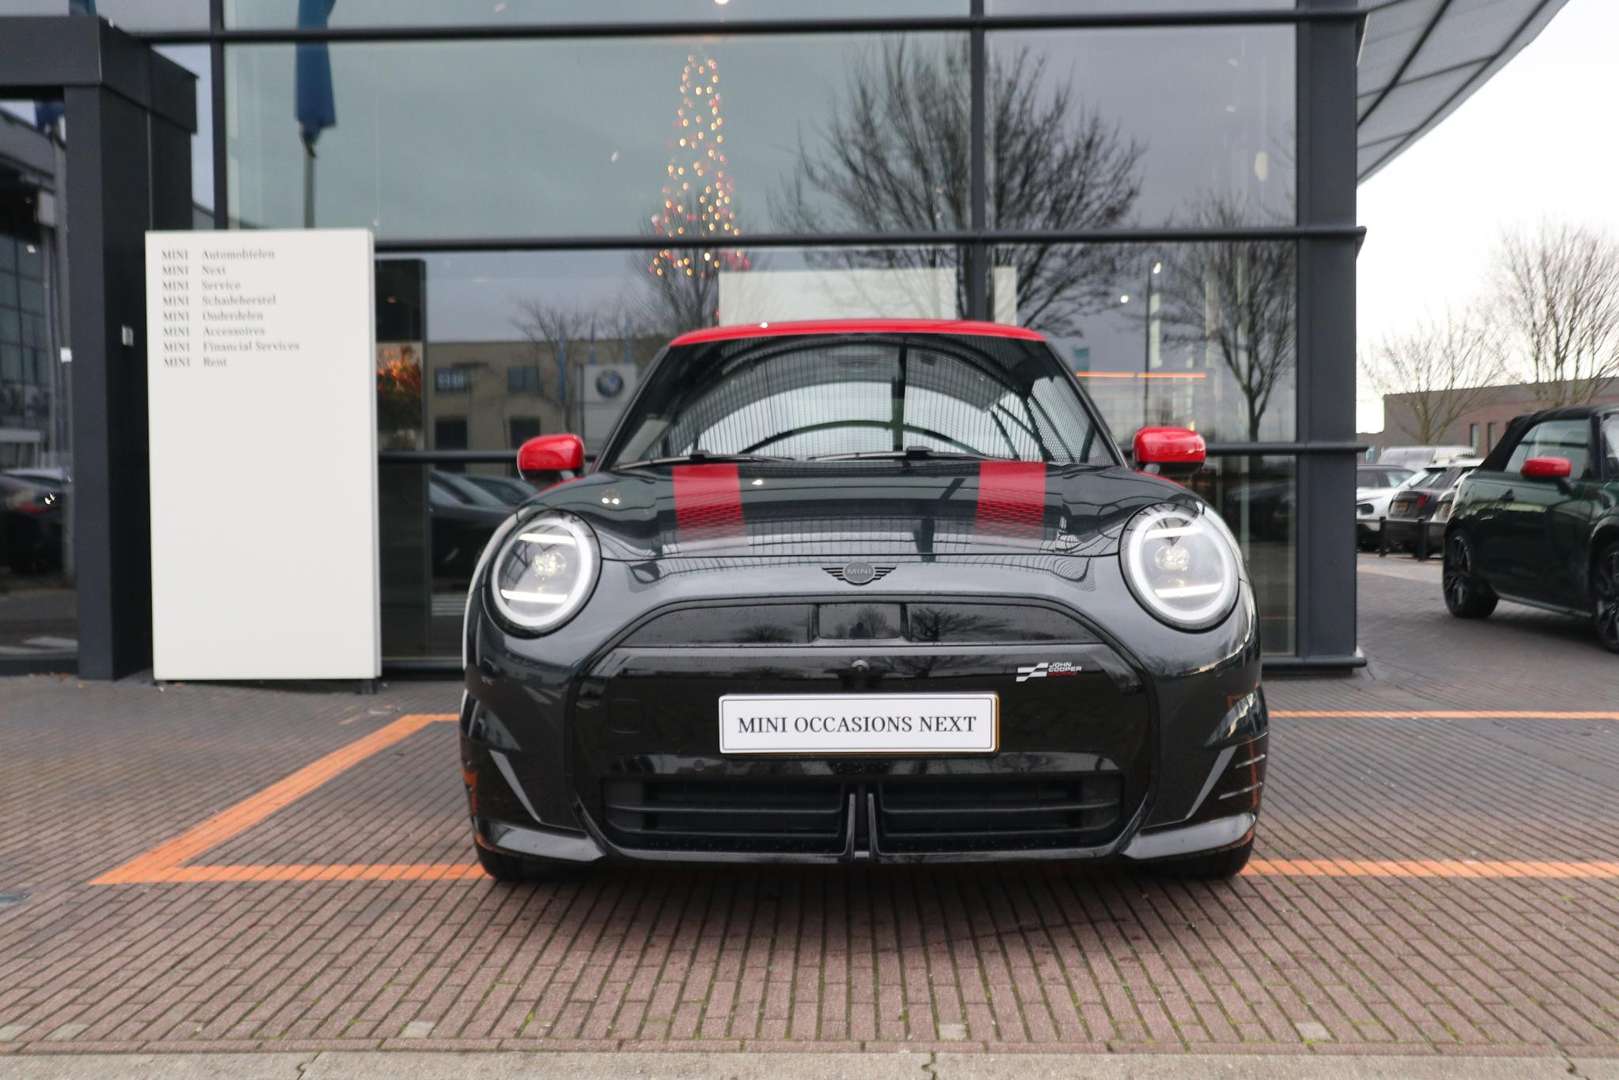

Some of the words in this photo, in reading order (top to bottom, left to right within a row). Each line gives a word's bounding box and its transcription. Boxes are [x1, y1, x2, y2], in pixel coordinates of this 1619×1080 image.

[161, 249, 189, 261] MINI
[162, 265, 189, 276] MINI
[202, 265, 226, 276] Next
[162, 280, 189, 291] MINI
[202, 280, 241, 291] Service
[163, 296, 190, 307] MINI
[163, 312, 190, 322] MINI
[202, 311, 264, 321] Onderdelen
[163, 327, 190, 338] MINI
[163, 342, 190, 353] MINI
[203, 342, 253, 353] Financial
[255, 341, 300, 352] Services
[164, 358, 191, 368] MINI
[203, 358, 227, 368] Rent
[847, 568, 872, 577] MINI
[738, 716, 788, 733] MINI
[793, 716, 913, 733] OCCASIONS
[919, 716, 977, 733] NEXT
